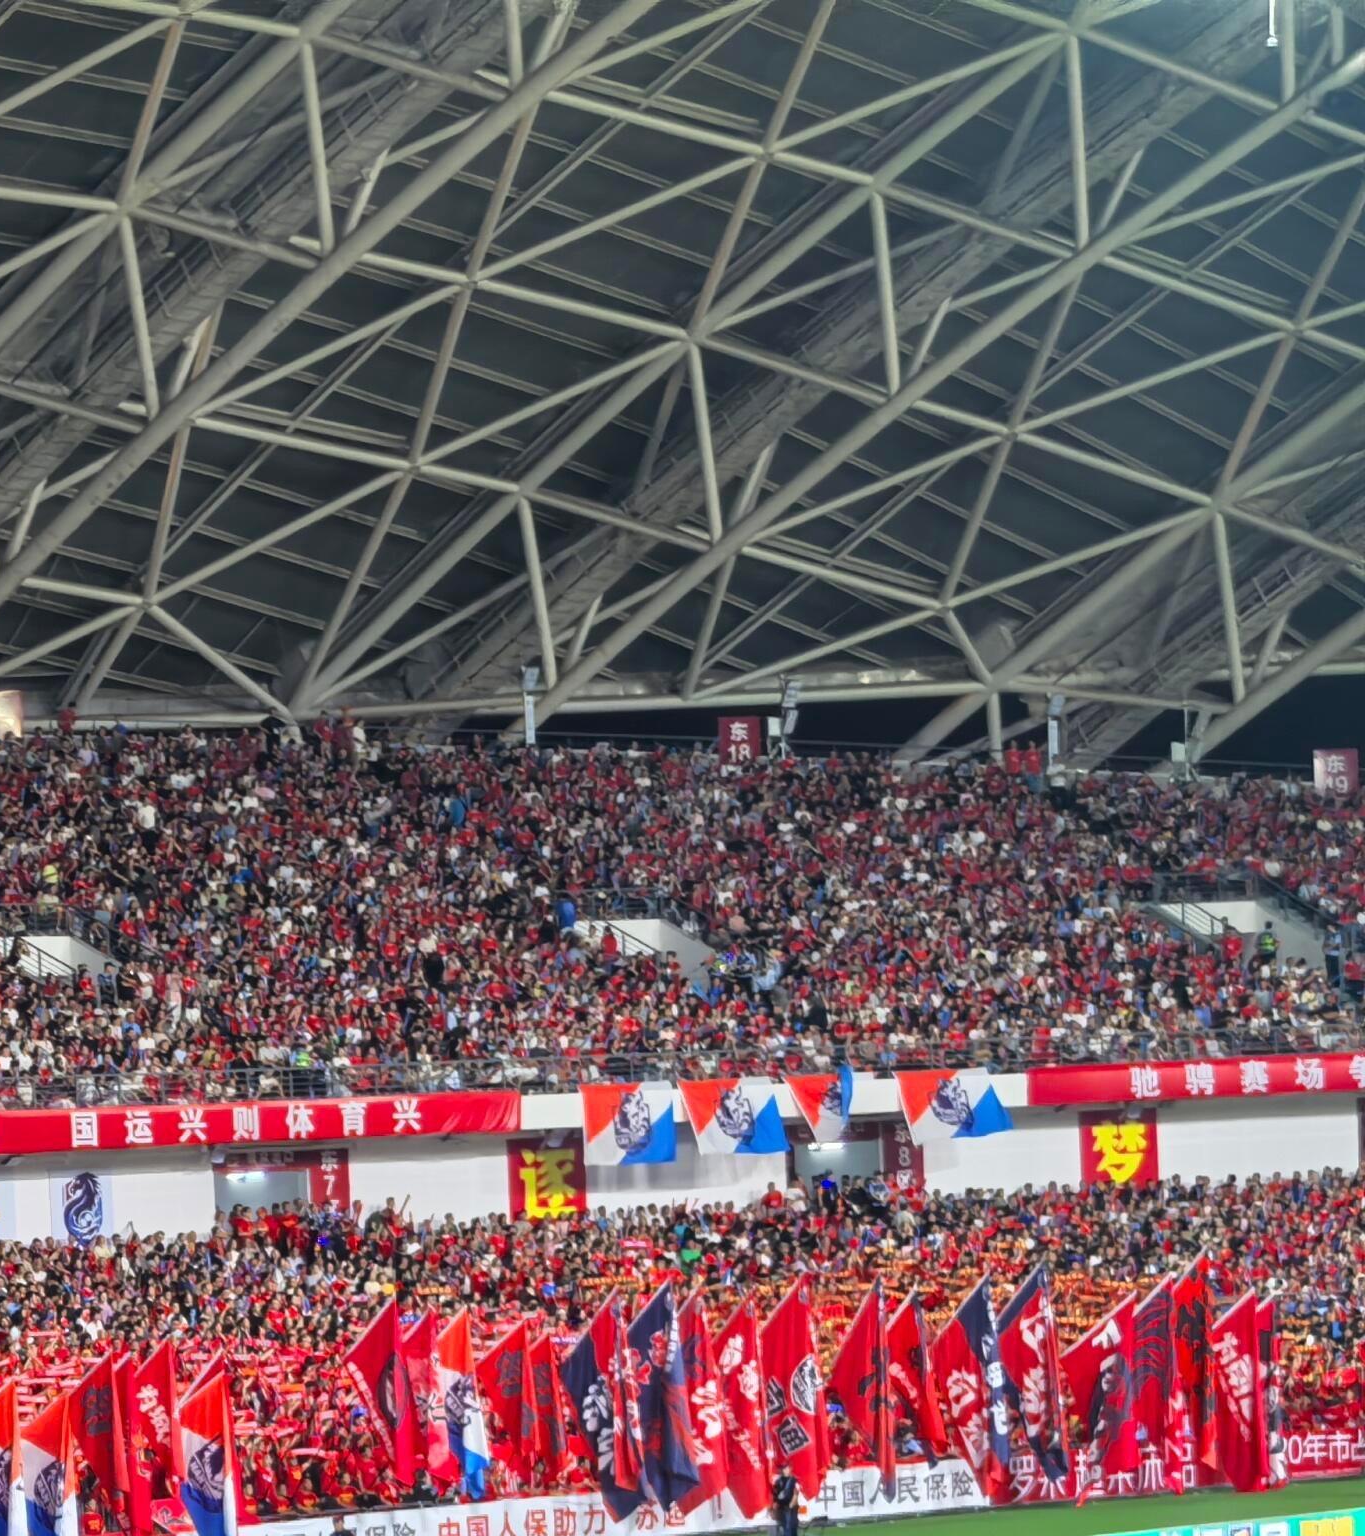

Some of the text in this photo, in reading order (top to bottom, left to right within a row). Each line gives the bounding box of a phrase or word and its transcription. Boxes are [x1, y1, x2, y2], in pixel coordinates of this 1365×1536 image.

[70, 1097, 423, 1148] 国运兴则体育兴
[1092, 1120, 1148, 1184] 梦
[519, 1148, 578, 1220] 逐
